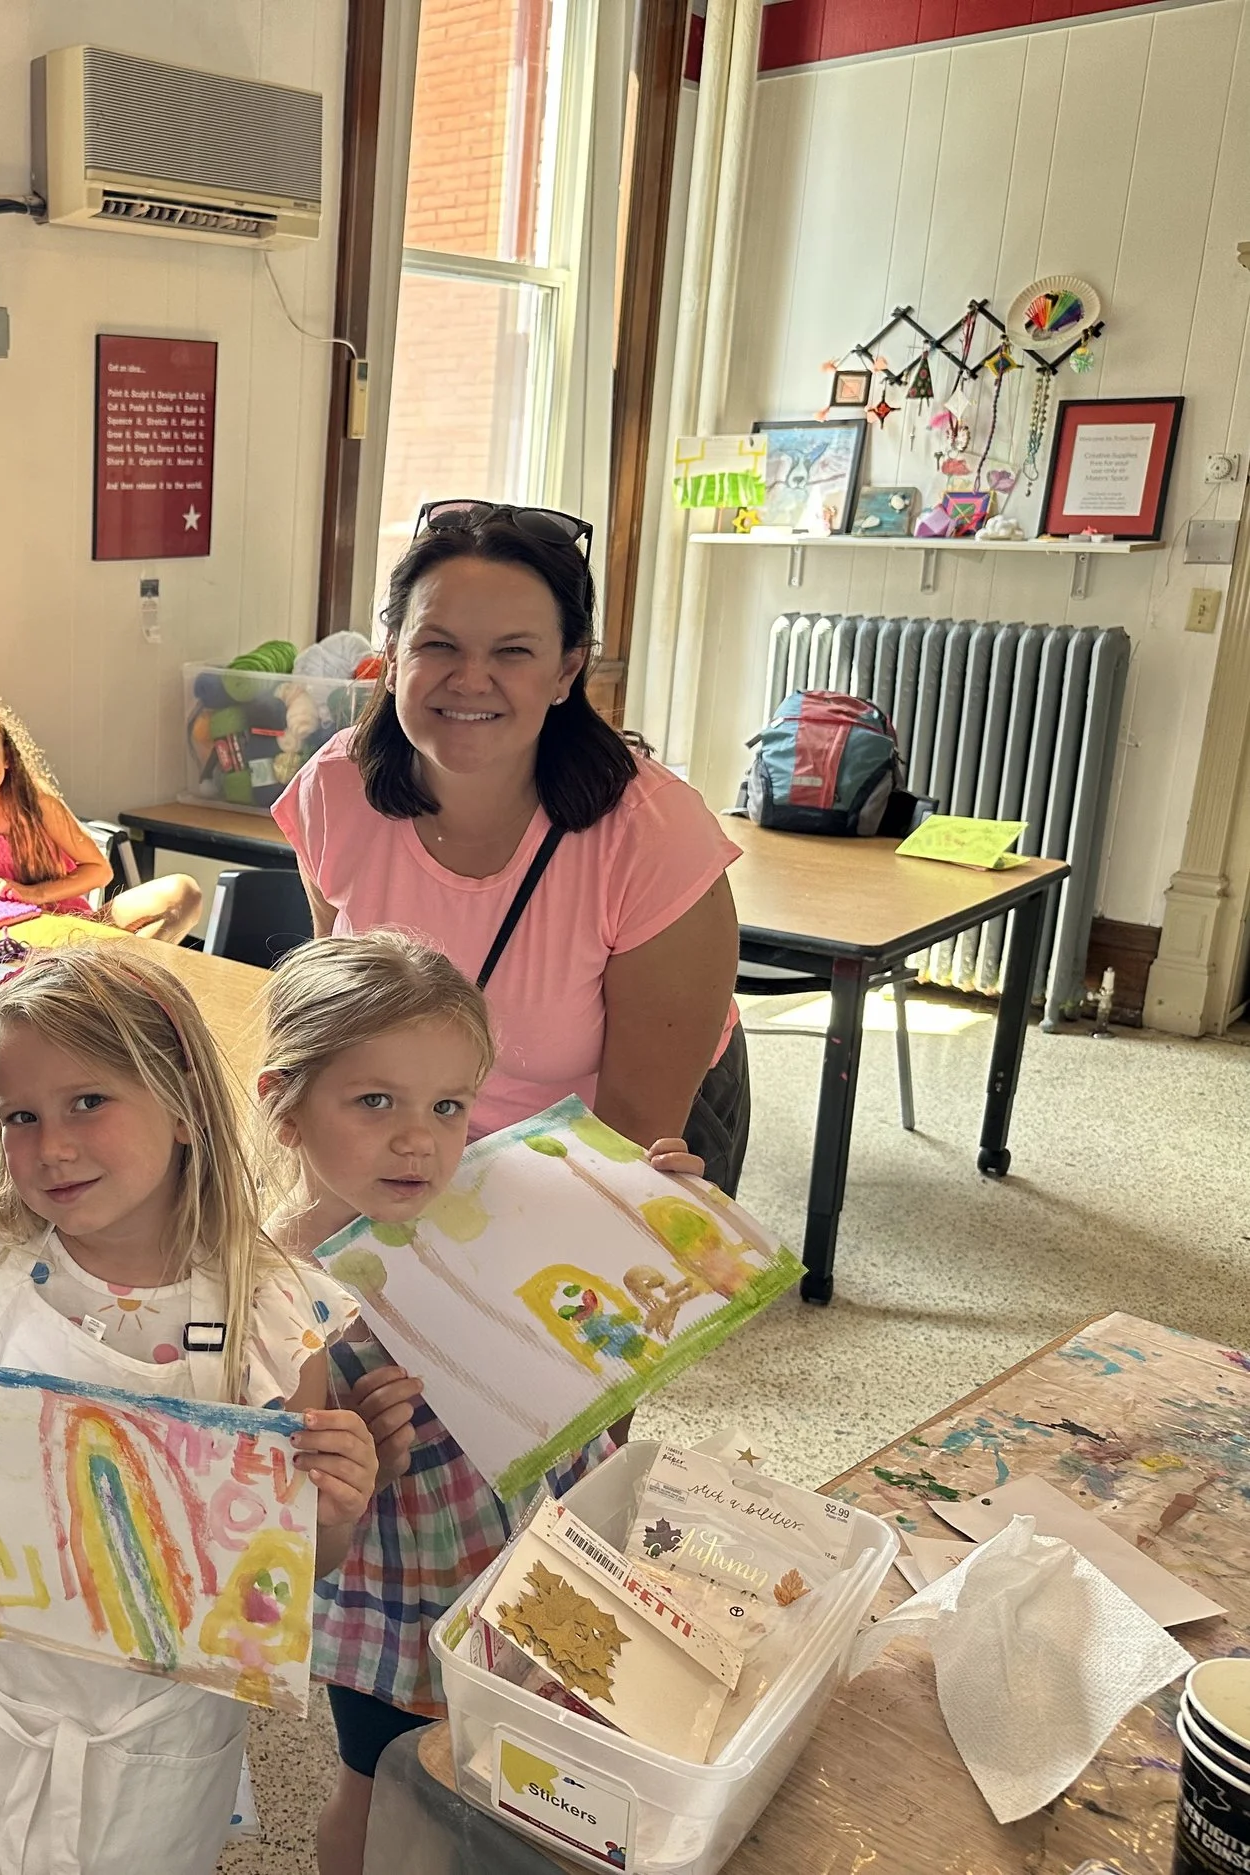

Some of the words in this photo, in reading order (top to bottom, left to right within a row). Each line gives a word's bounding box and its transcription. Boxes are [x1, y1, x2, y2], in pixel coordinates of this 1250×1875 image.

[107, 362, 119, 372] Get
[107, 388, 123, 398] Paint
[131, 389, 150, 400] Sculpt
[157, 391, 177, 402] Design
[184, 391, 200, 400] Build
[106, 430, 123, 439] Grow
[133, 444, 148, 454] Sing
[174, 481, 184, 490] the
[661, 1453, 686, 1466] paper
[688, 1484, 725, 1504] stick
[729, 1499, 741, 1509] a
[824, 1503, 850, 1519] $2.99
[648, 1528, 769, 1593] Autumn
[528, 1782, 597, 1825] Stickers
